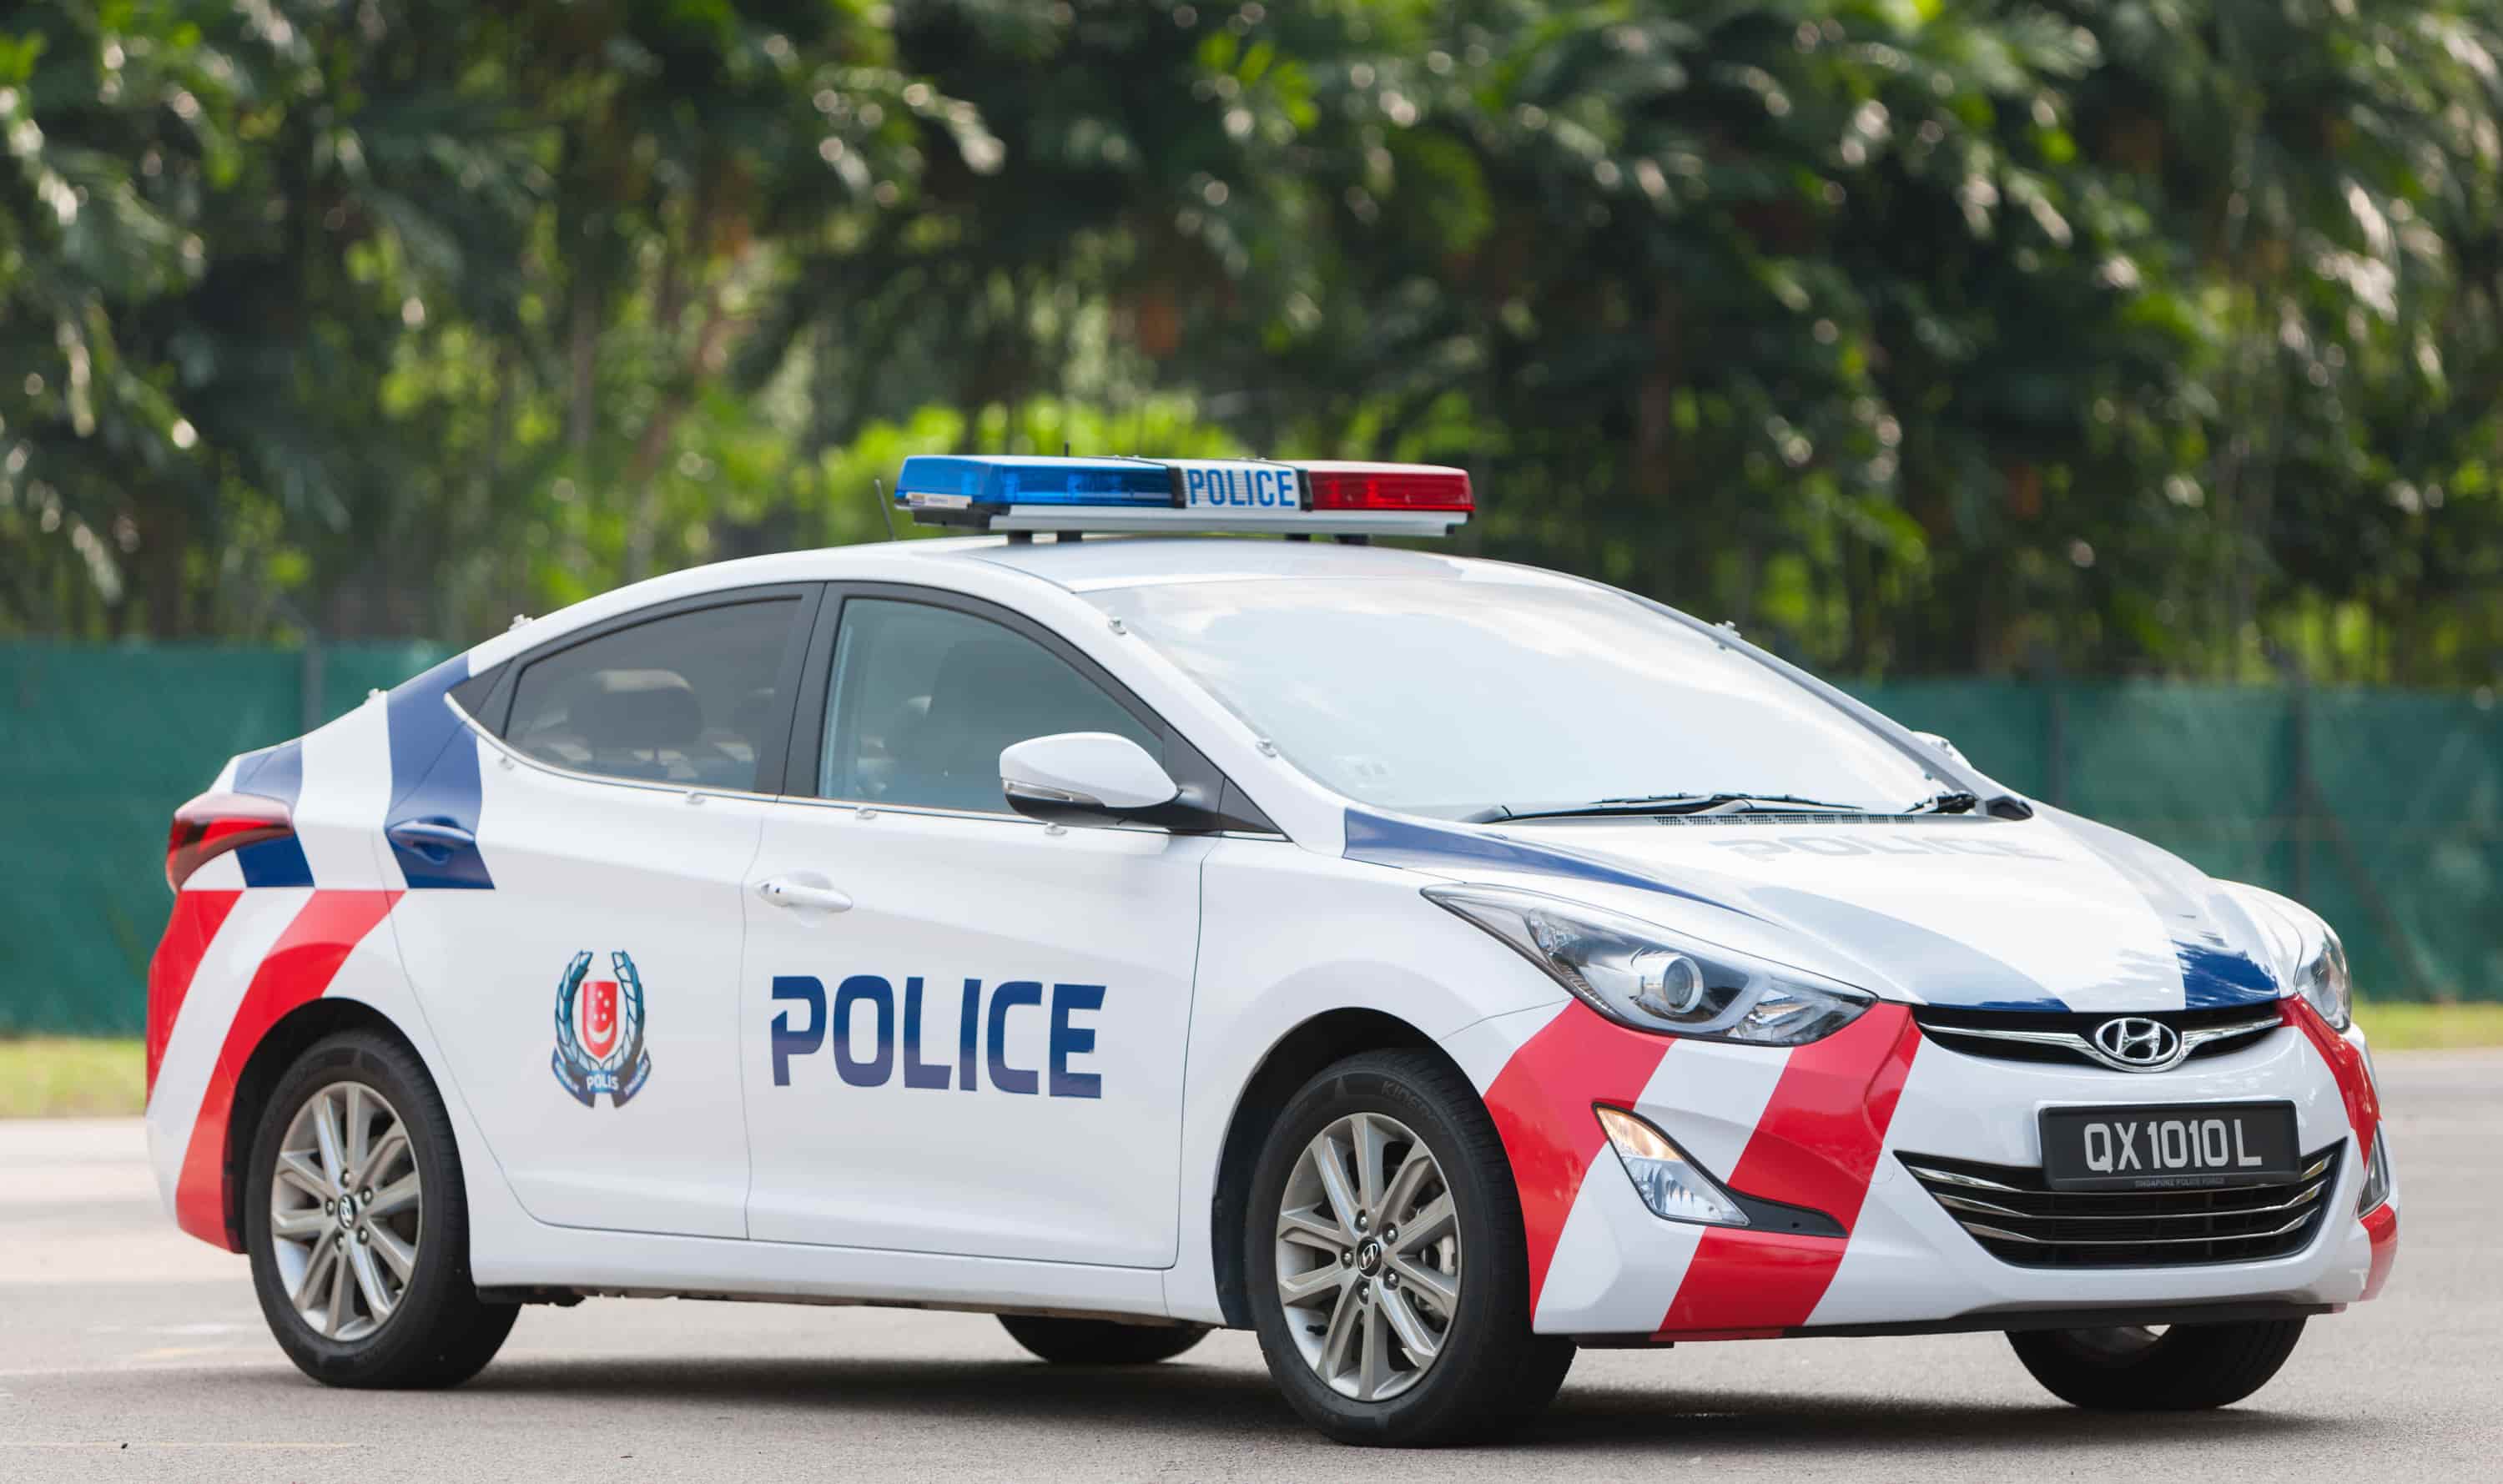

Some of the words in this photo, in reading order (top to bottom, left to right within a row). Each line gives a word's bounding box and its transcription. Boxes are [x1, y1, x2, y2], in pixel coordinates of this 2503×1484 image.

[1187, 469, 1295, 506] POLICE
[771, 974, 1106, 1099] POLICE
[587, 1074, 619, 1091] POLIS
